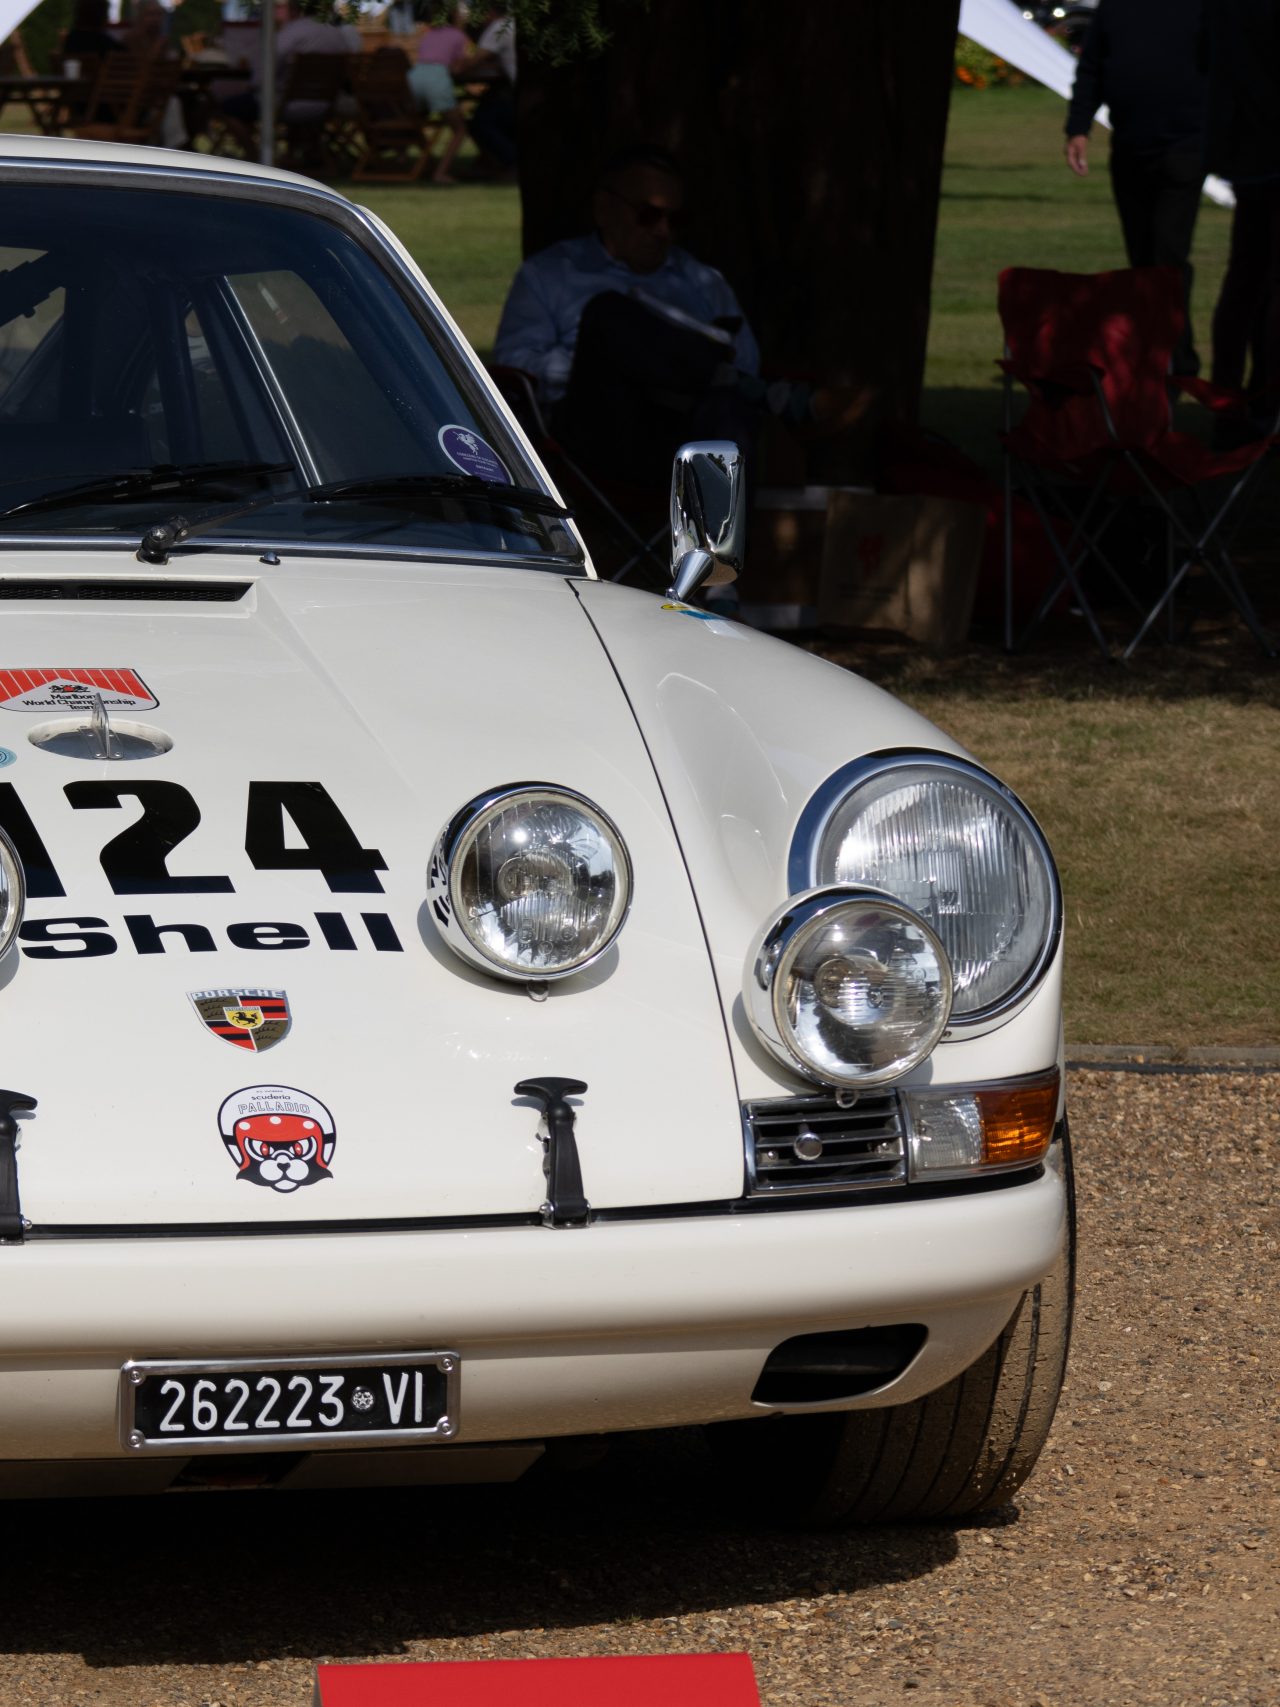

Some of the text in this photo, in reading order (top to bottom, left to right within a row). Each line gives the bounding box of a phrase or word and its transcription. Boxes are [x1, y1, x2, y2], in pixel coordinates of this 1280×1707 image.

[18, 911, 405, 960] Shell
[191, 989, 284, 1001] PORSCHE
[251, 1093, 291, 1101] scuderia
[237, 1101, 311, 1115] PALLADIO
[160, 1371, 423, 1432] 262223 VI
